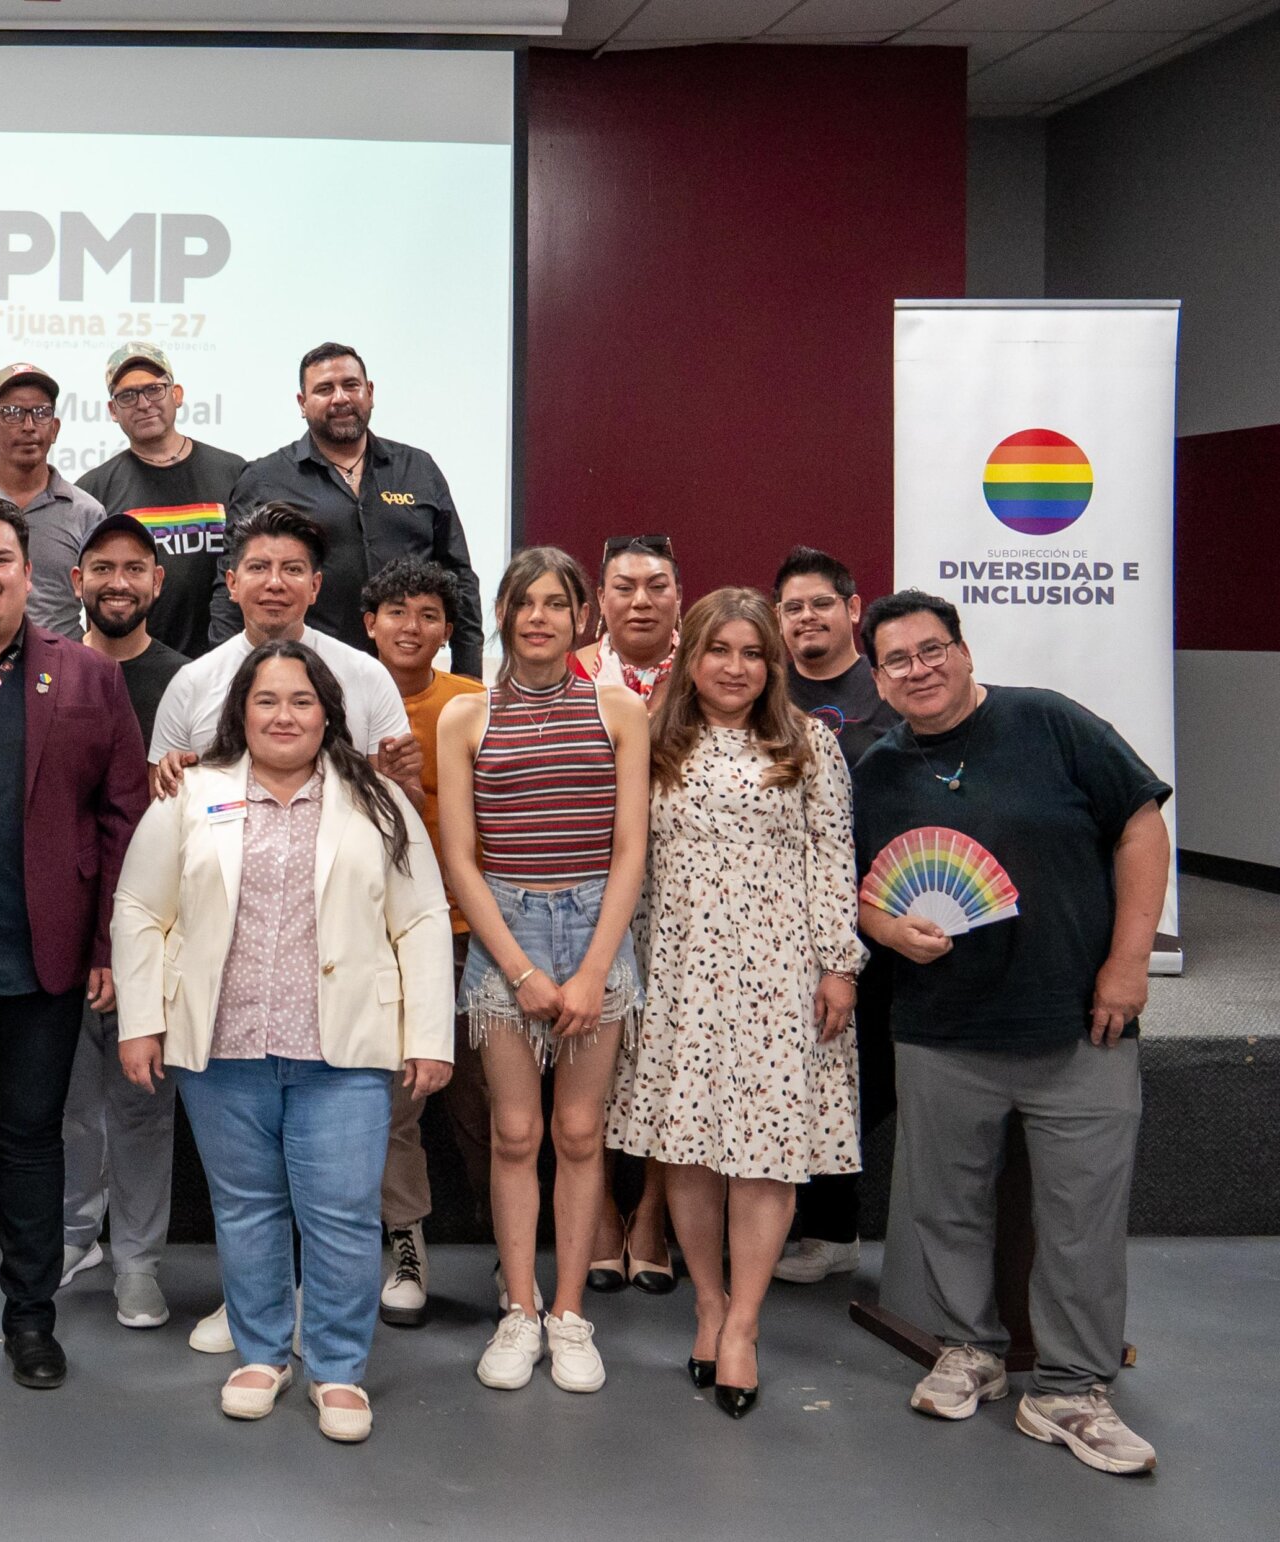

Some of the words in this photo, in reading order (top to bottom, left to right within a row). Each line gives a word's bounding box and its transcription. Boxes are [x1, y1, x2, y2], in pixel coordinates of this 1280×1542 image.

[23, 338, 78, 350] Programa
[150, 522, 225, 555] RIDE
[987, 548, 1070, 559] SUBDIRECCIÓN
[1073, 549, 1088, 559] DE
[939, 560, 1114, 581] DIVERSIDAD
[1123, 562, 1140, 581] E
[962, 581, 1115, 605] INCLUSIÓN
